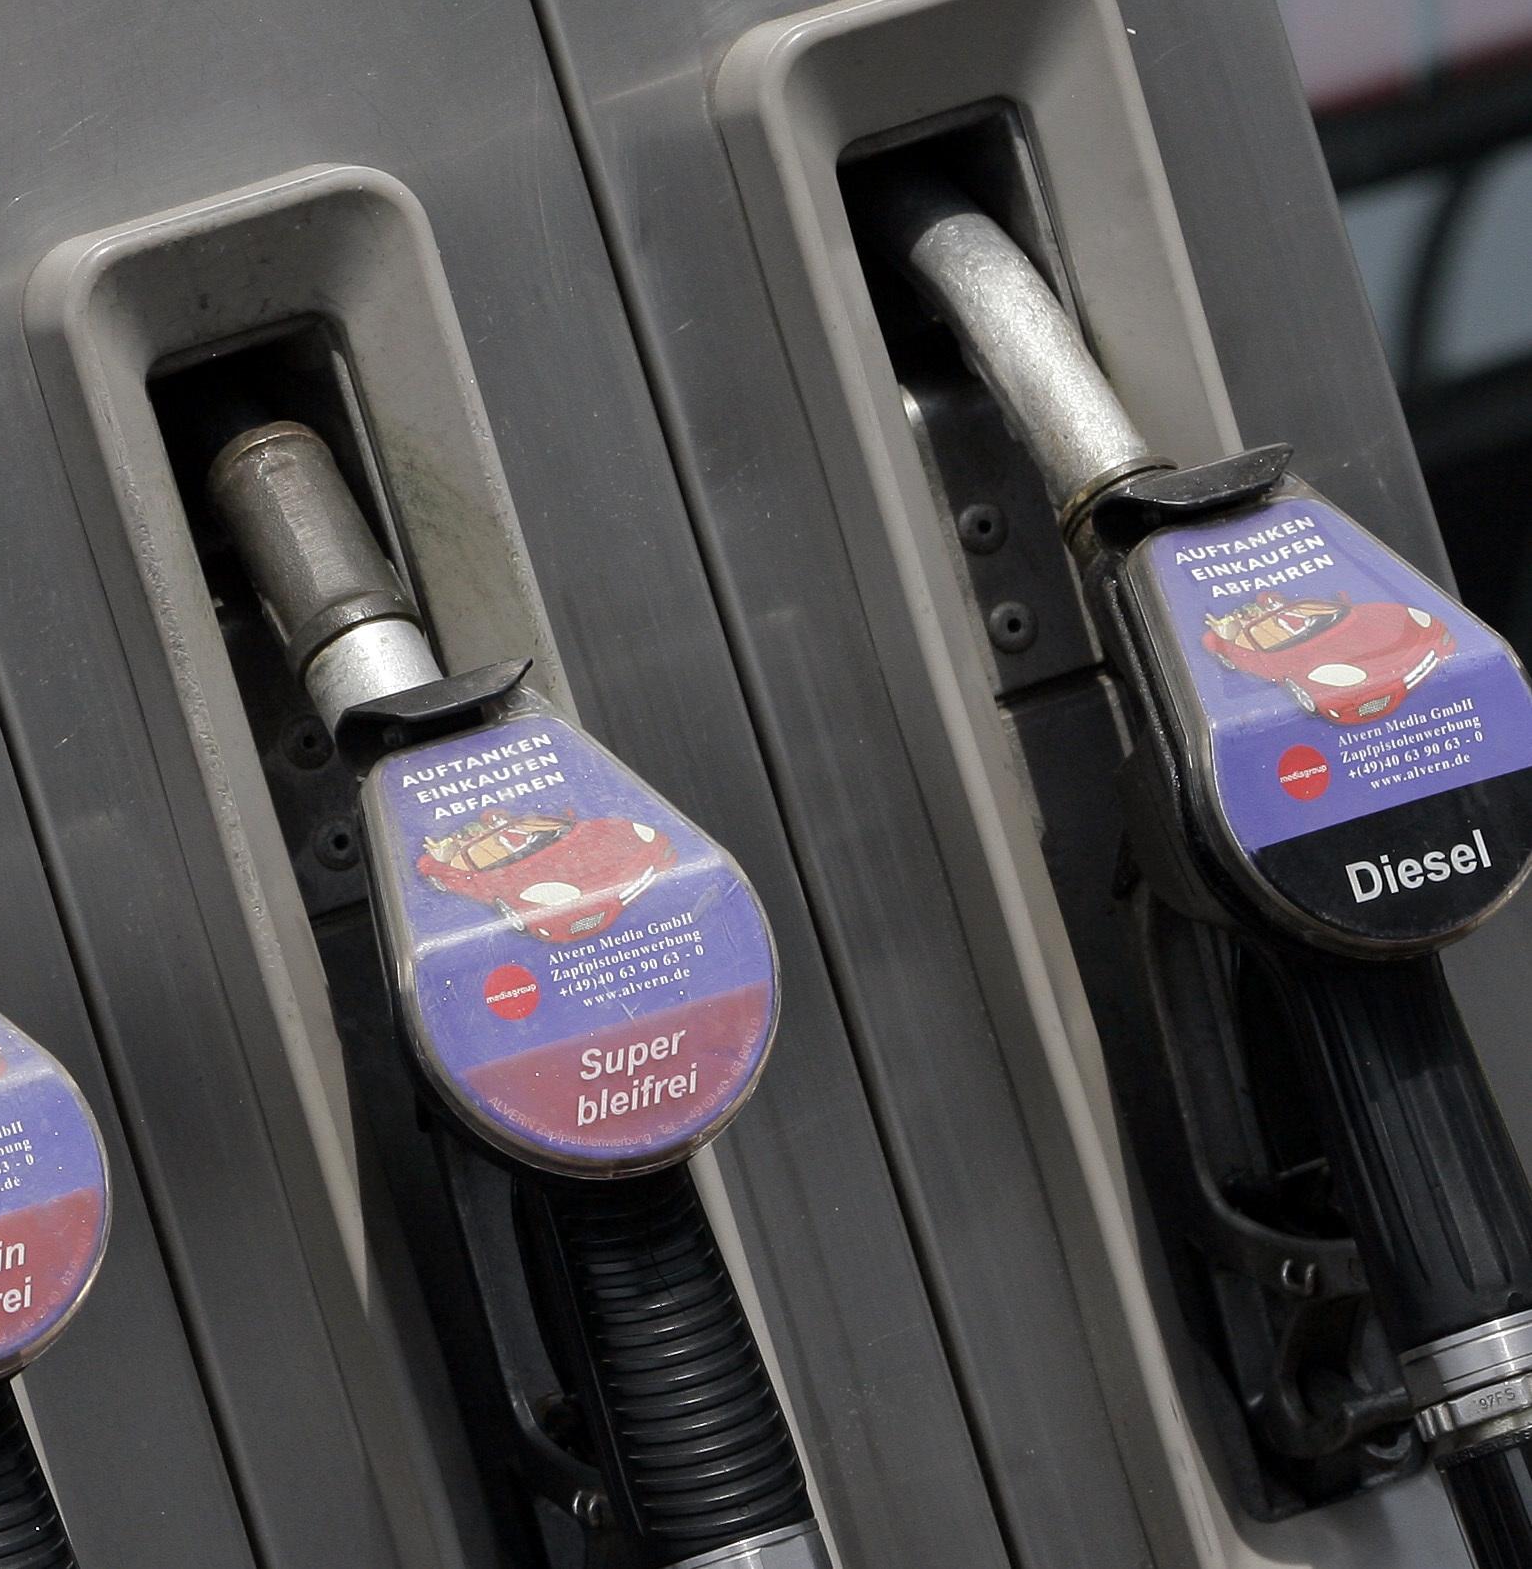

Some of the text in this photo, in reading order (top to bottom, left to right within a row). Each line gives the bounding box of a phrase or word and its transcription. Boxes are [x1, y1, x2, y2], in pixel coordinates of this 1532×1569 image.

[1175, 516, 1316, 565] AUFTANKEN
[1190, 534, 1325, 582] EINKAUFEN
[1211, 553, 1335, 598] ABFAHREN
[1338, 698, 1474, 747] Alvern Media GmbH
[1340, 715, 1481, 764] Zapfpistolenwerbung
[401, 733, 552, 788] AUFTANKEN
[416, 751, 559, 804] EINKAUFEN
[1280, 764, 1327, 784] mediagroup
[1348, 756, 1400, 779] +(49)40
[1404, 748, 1420, 763] 63
[1424, 742, 1440, 757] 90
[1444, 737, 1461, 751] 63
[1474, 731, 1484, 743] 0
[1370, 752, 1471, 790] www.alvern.de
[433, 770, 566, 820] ABFAHREN
[1345, 828, 1493, 904] Diesel
[549, 912, 694, 966] Alvern Media GmbH
[550, 929, 702, 982] Zapfpistolenwerbung
[486, 983, 537, 1005] mediagroup
[559, 971, 614, 999] +(49)40
[619, 964, 636, 980] 63
[641, 957, 658, 973] 90
[662, 952, 680, 967] 63
[695, 944, 705, 956] 0
[583, 966, 691, 1008] www.alvern.de
[579, 1029, 687, 1081] Super
[488, 1096, 535, 1130] ALVERN
[577, 1062, 698, 1126] bleifrei
[25, 1153, 35, 1166] 0
